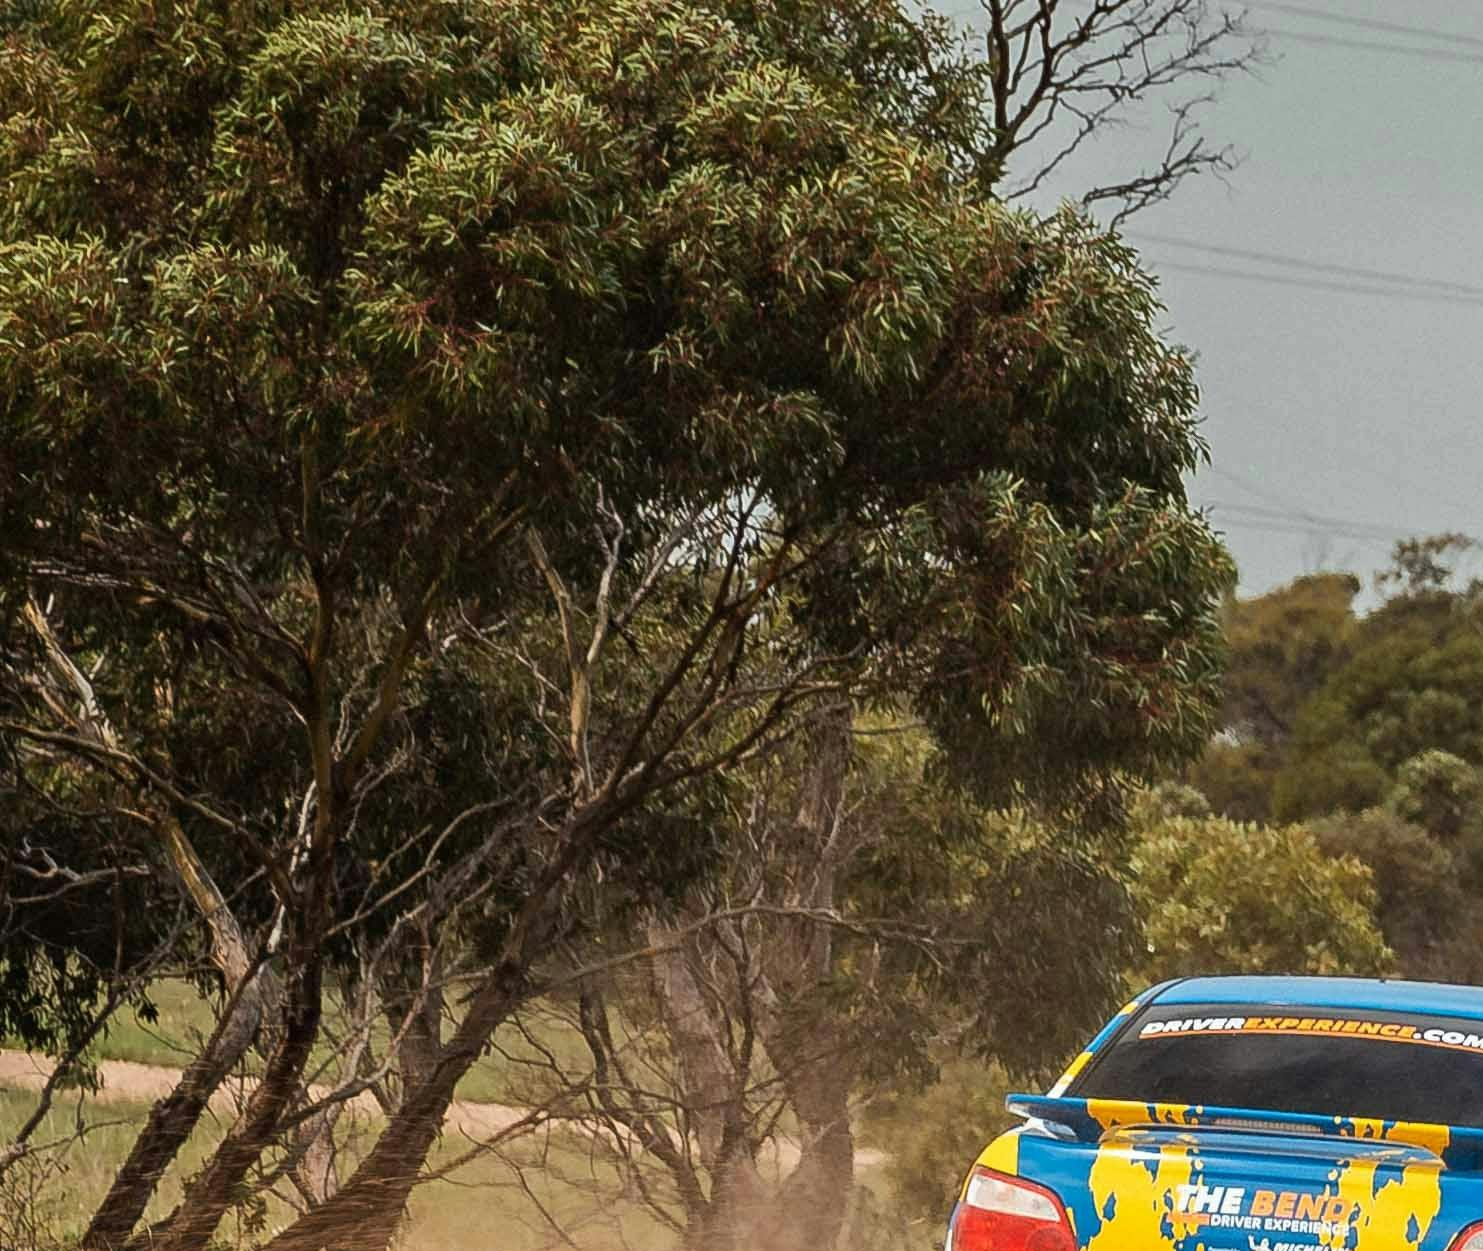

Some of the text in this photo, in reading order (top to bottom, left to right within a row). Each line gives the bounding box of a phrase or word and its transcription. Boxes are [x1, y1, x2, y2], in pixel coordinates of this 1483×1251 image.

[1176, 1184, 1350, 1221] THE BEND
[1210, 1214, 1350, 1236] DRIVER EXPERIENCE
